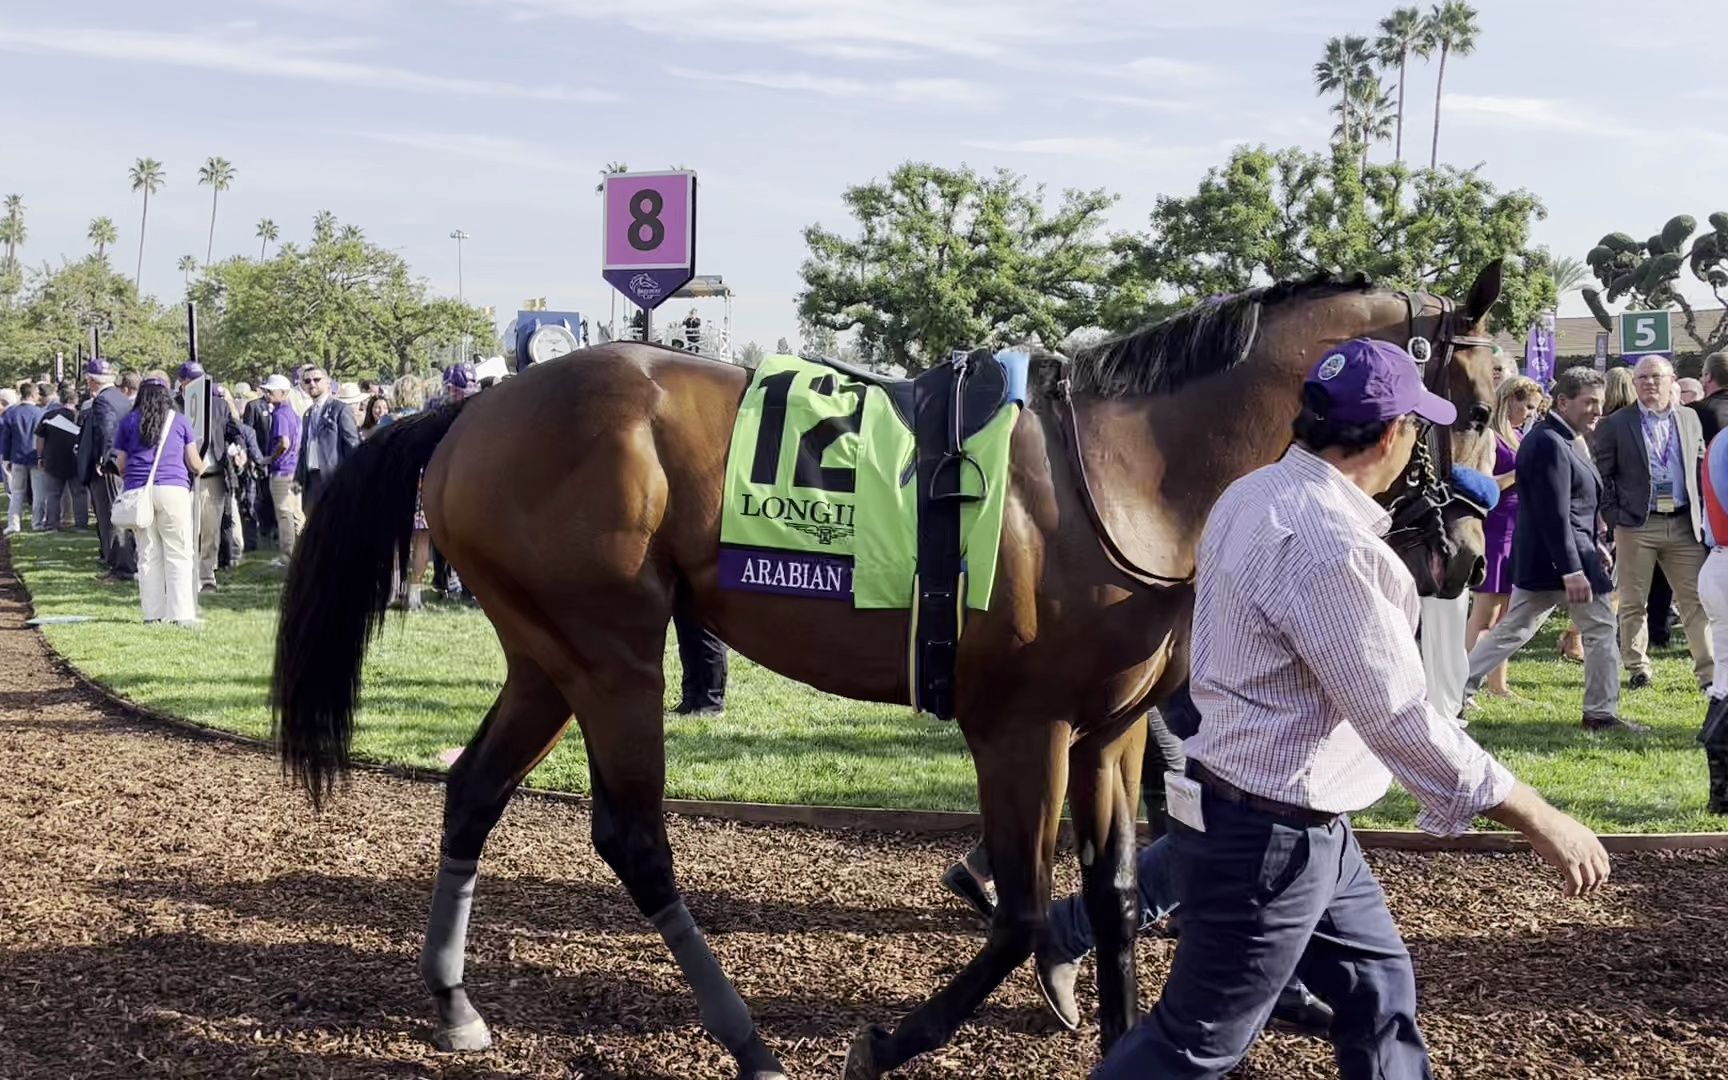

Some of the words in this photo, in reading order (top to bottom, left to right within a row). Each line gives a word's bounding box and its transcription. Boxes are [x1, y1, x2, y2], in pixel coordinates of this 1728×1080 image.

[627, 189, 665, 251] 8
[1635, 318, 1656, 347] 5
[190, 392, 198, 430] 9
[750, 370, 868, 493] 12
[740, 494, 855, 527] LONGI
[741, 557, 842, 592] ARABIAN
